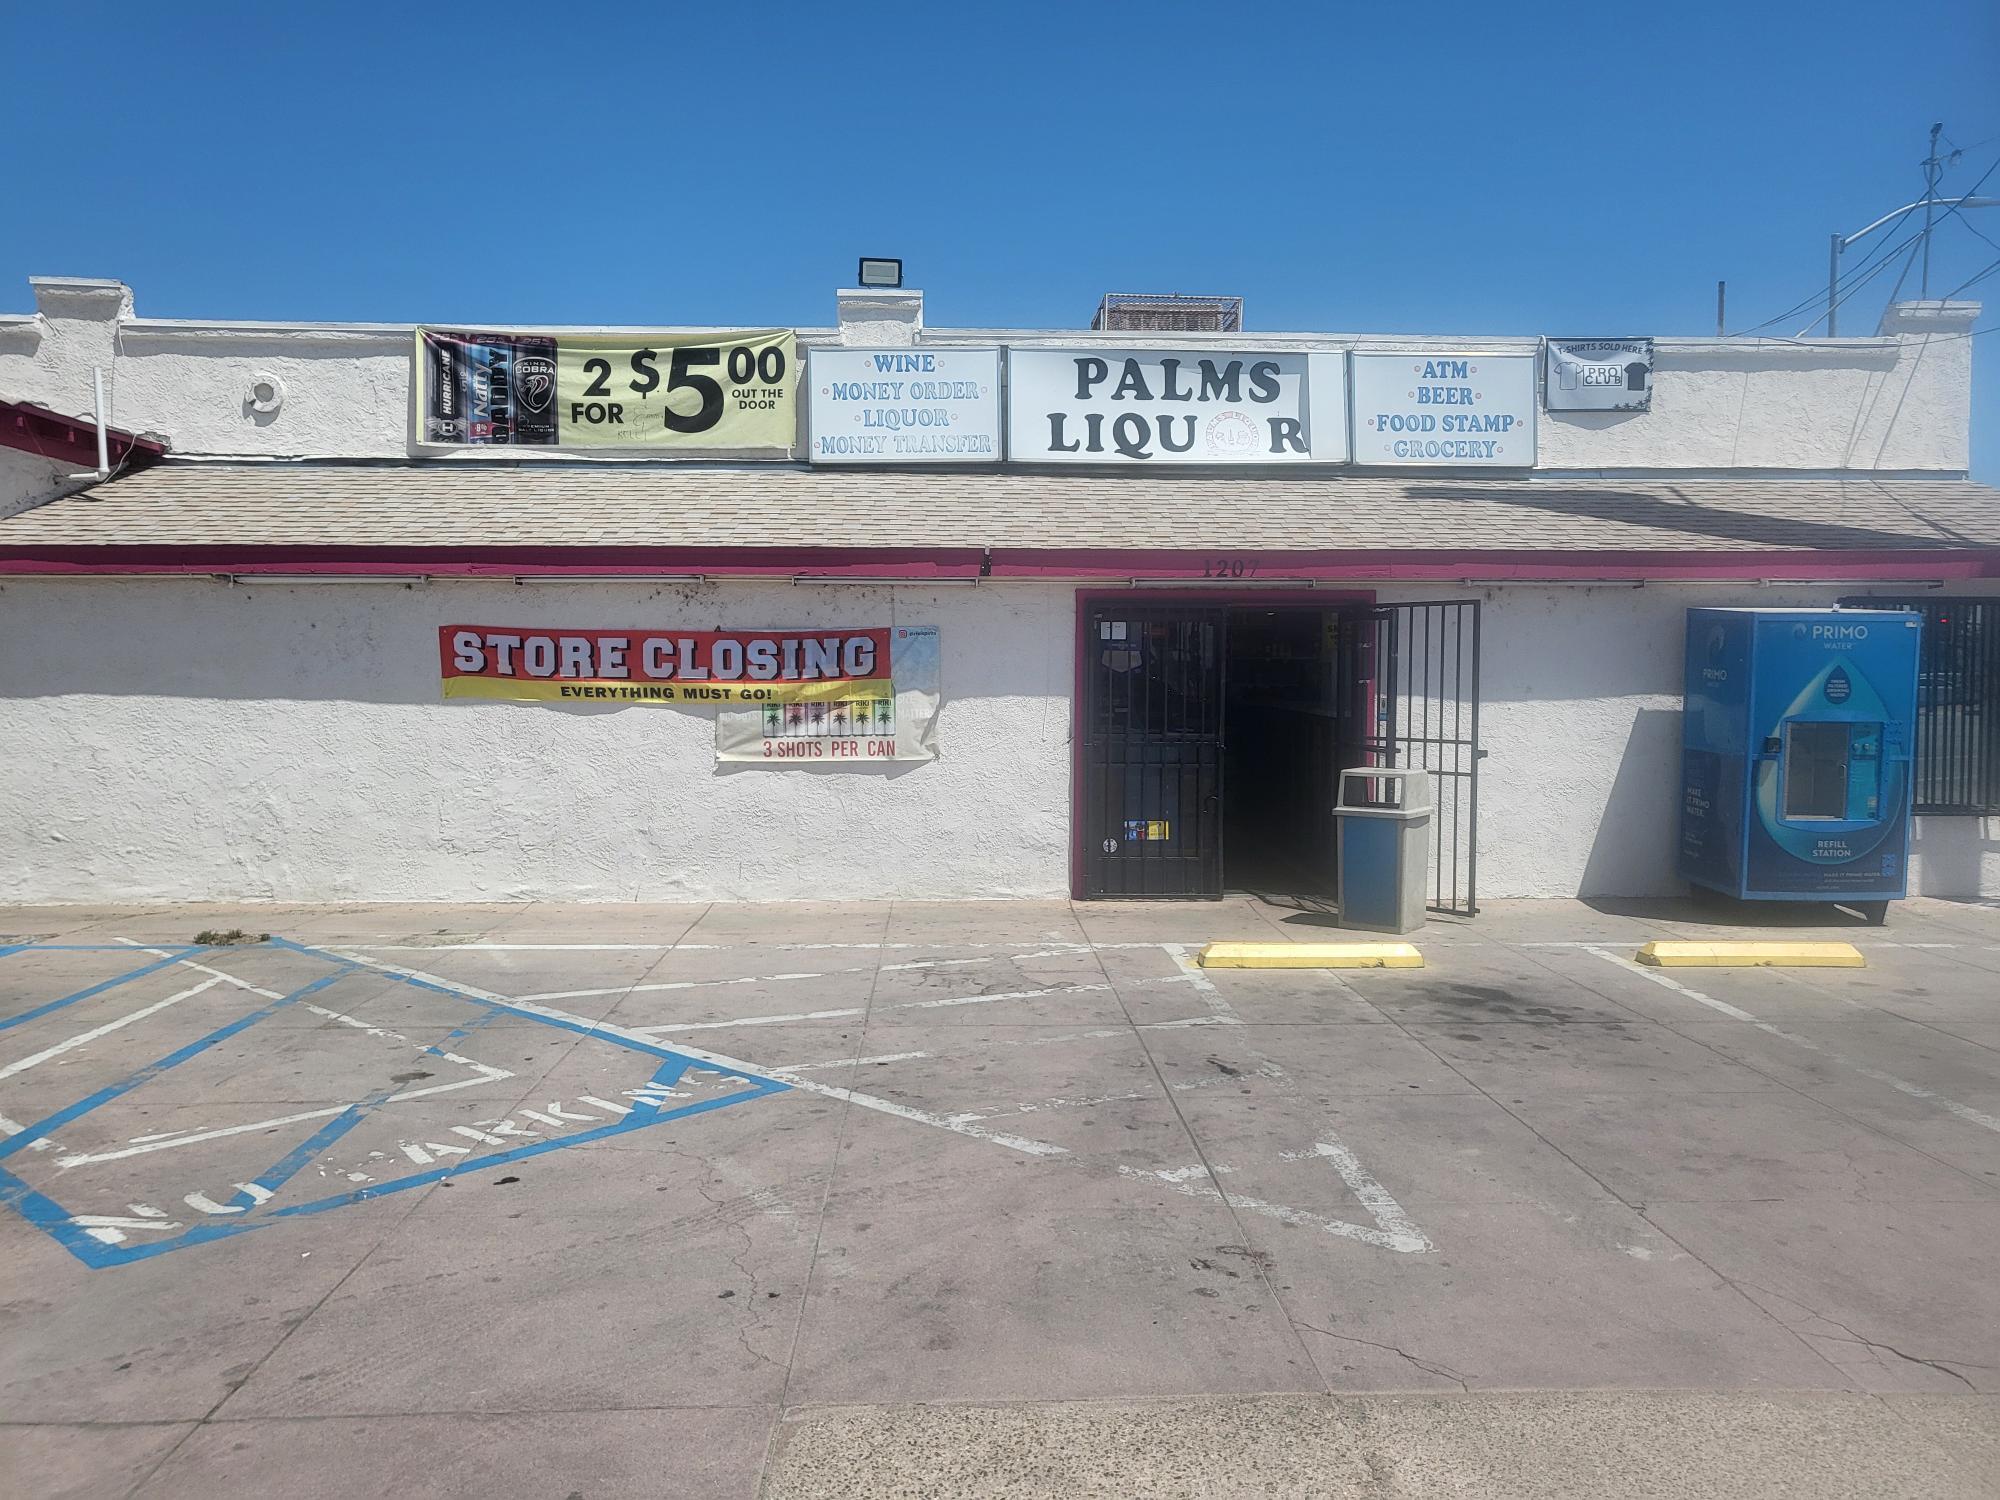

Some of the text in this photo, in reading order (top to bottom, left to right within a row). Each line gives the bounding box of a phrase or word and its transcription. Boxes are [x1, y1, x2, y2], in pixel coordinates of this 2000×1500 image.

[1558, 342, 1643, 354] T-SHIRTS SOLD HERE
[515, 365, 555, 375] COBRA
[873, 354, 936, 373] WINE
[1421, 360, 1468, 379] ATM
[1588, 367, 1618, 378] PRO
[441, 349, 452, 415] HURRICANE
[582, 357, 612, 397] 2
[1073, 357, 1281, 404] PALMS
[1585, 375, 1621, 385] CLUB
[473, 362, 493, 418] Natty
[731, 388, 784, 399] OUT THE
[831, 381, 980, 401] MONEY ORDER
[1416, 386, 1475, 406] BEER
[571, 402, 624, 424] FOR
[738, 400, 776, 410] DOOR
[863, 408, 950, 431] LIQUOR
[1376, 414, 1515, 433] FOOD STAMP
[821, 434, 993, 455] MONEY TRANSFER
[1393, 440, 1498, 458] GROCERY
[1202, 559, 1261, 578] 1207
[1812, 625, 1869, 640] PRIMO
[1823, 642, 1853, 650] WATER
[452, 631, 877, 681] STORE CLOSING
[1703, 668, 1728, 682] PRIMO
[560, 685, 772, 700] EVERYTHING MUST GO!
[763, 740, 896, 758] 3 SHOTS PER CAN
[1812, 849, 1851, 858] STATION
[1817, 840, 1848, 849] REFILL
